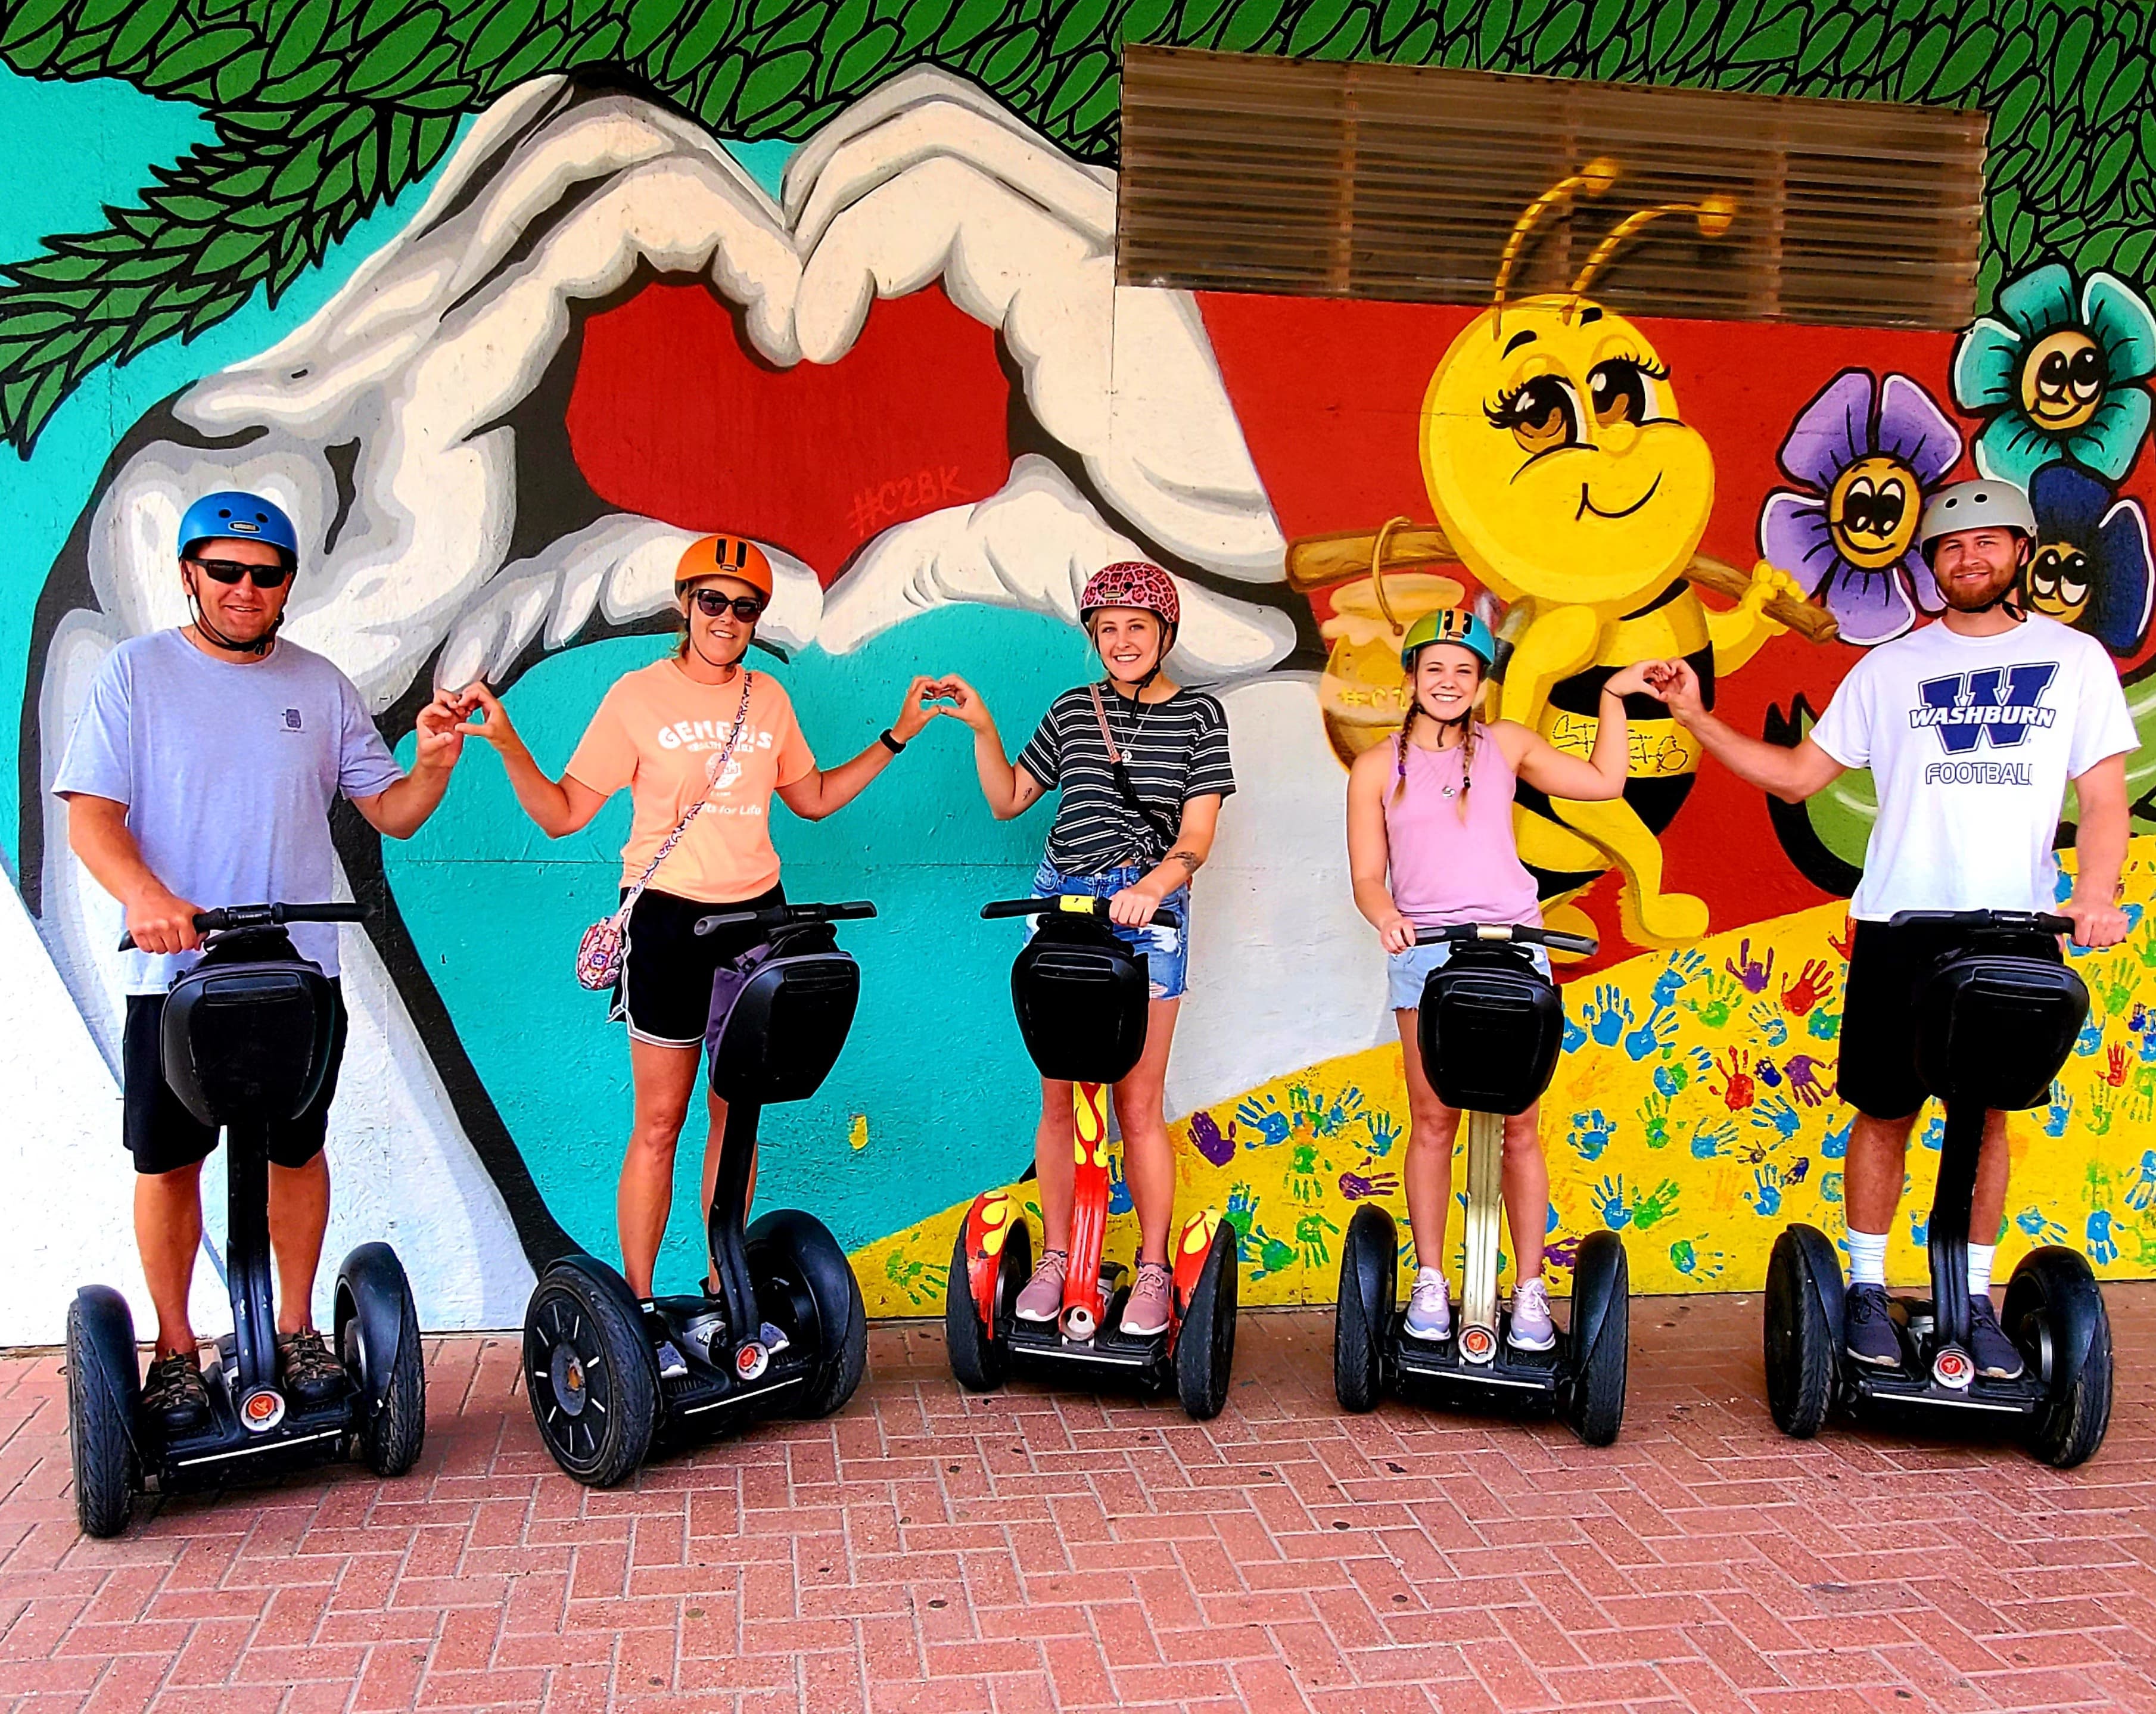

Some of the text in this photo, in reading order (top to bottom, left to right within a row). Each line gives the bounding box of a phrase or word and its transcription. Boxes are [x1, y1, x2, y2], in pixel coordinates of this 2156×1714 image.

[1909, 705, 2057, 729] WASHBURN
[719, 805, 738, 816] for
[739, 804, 762, 816] Life
